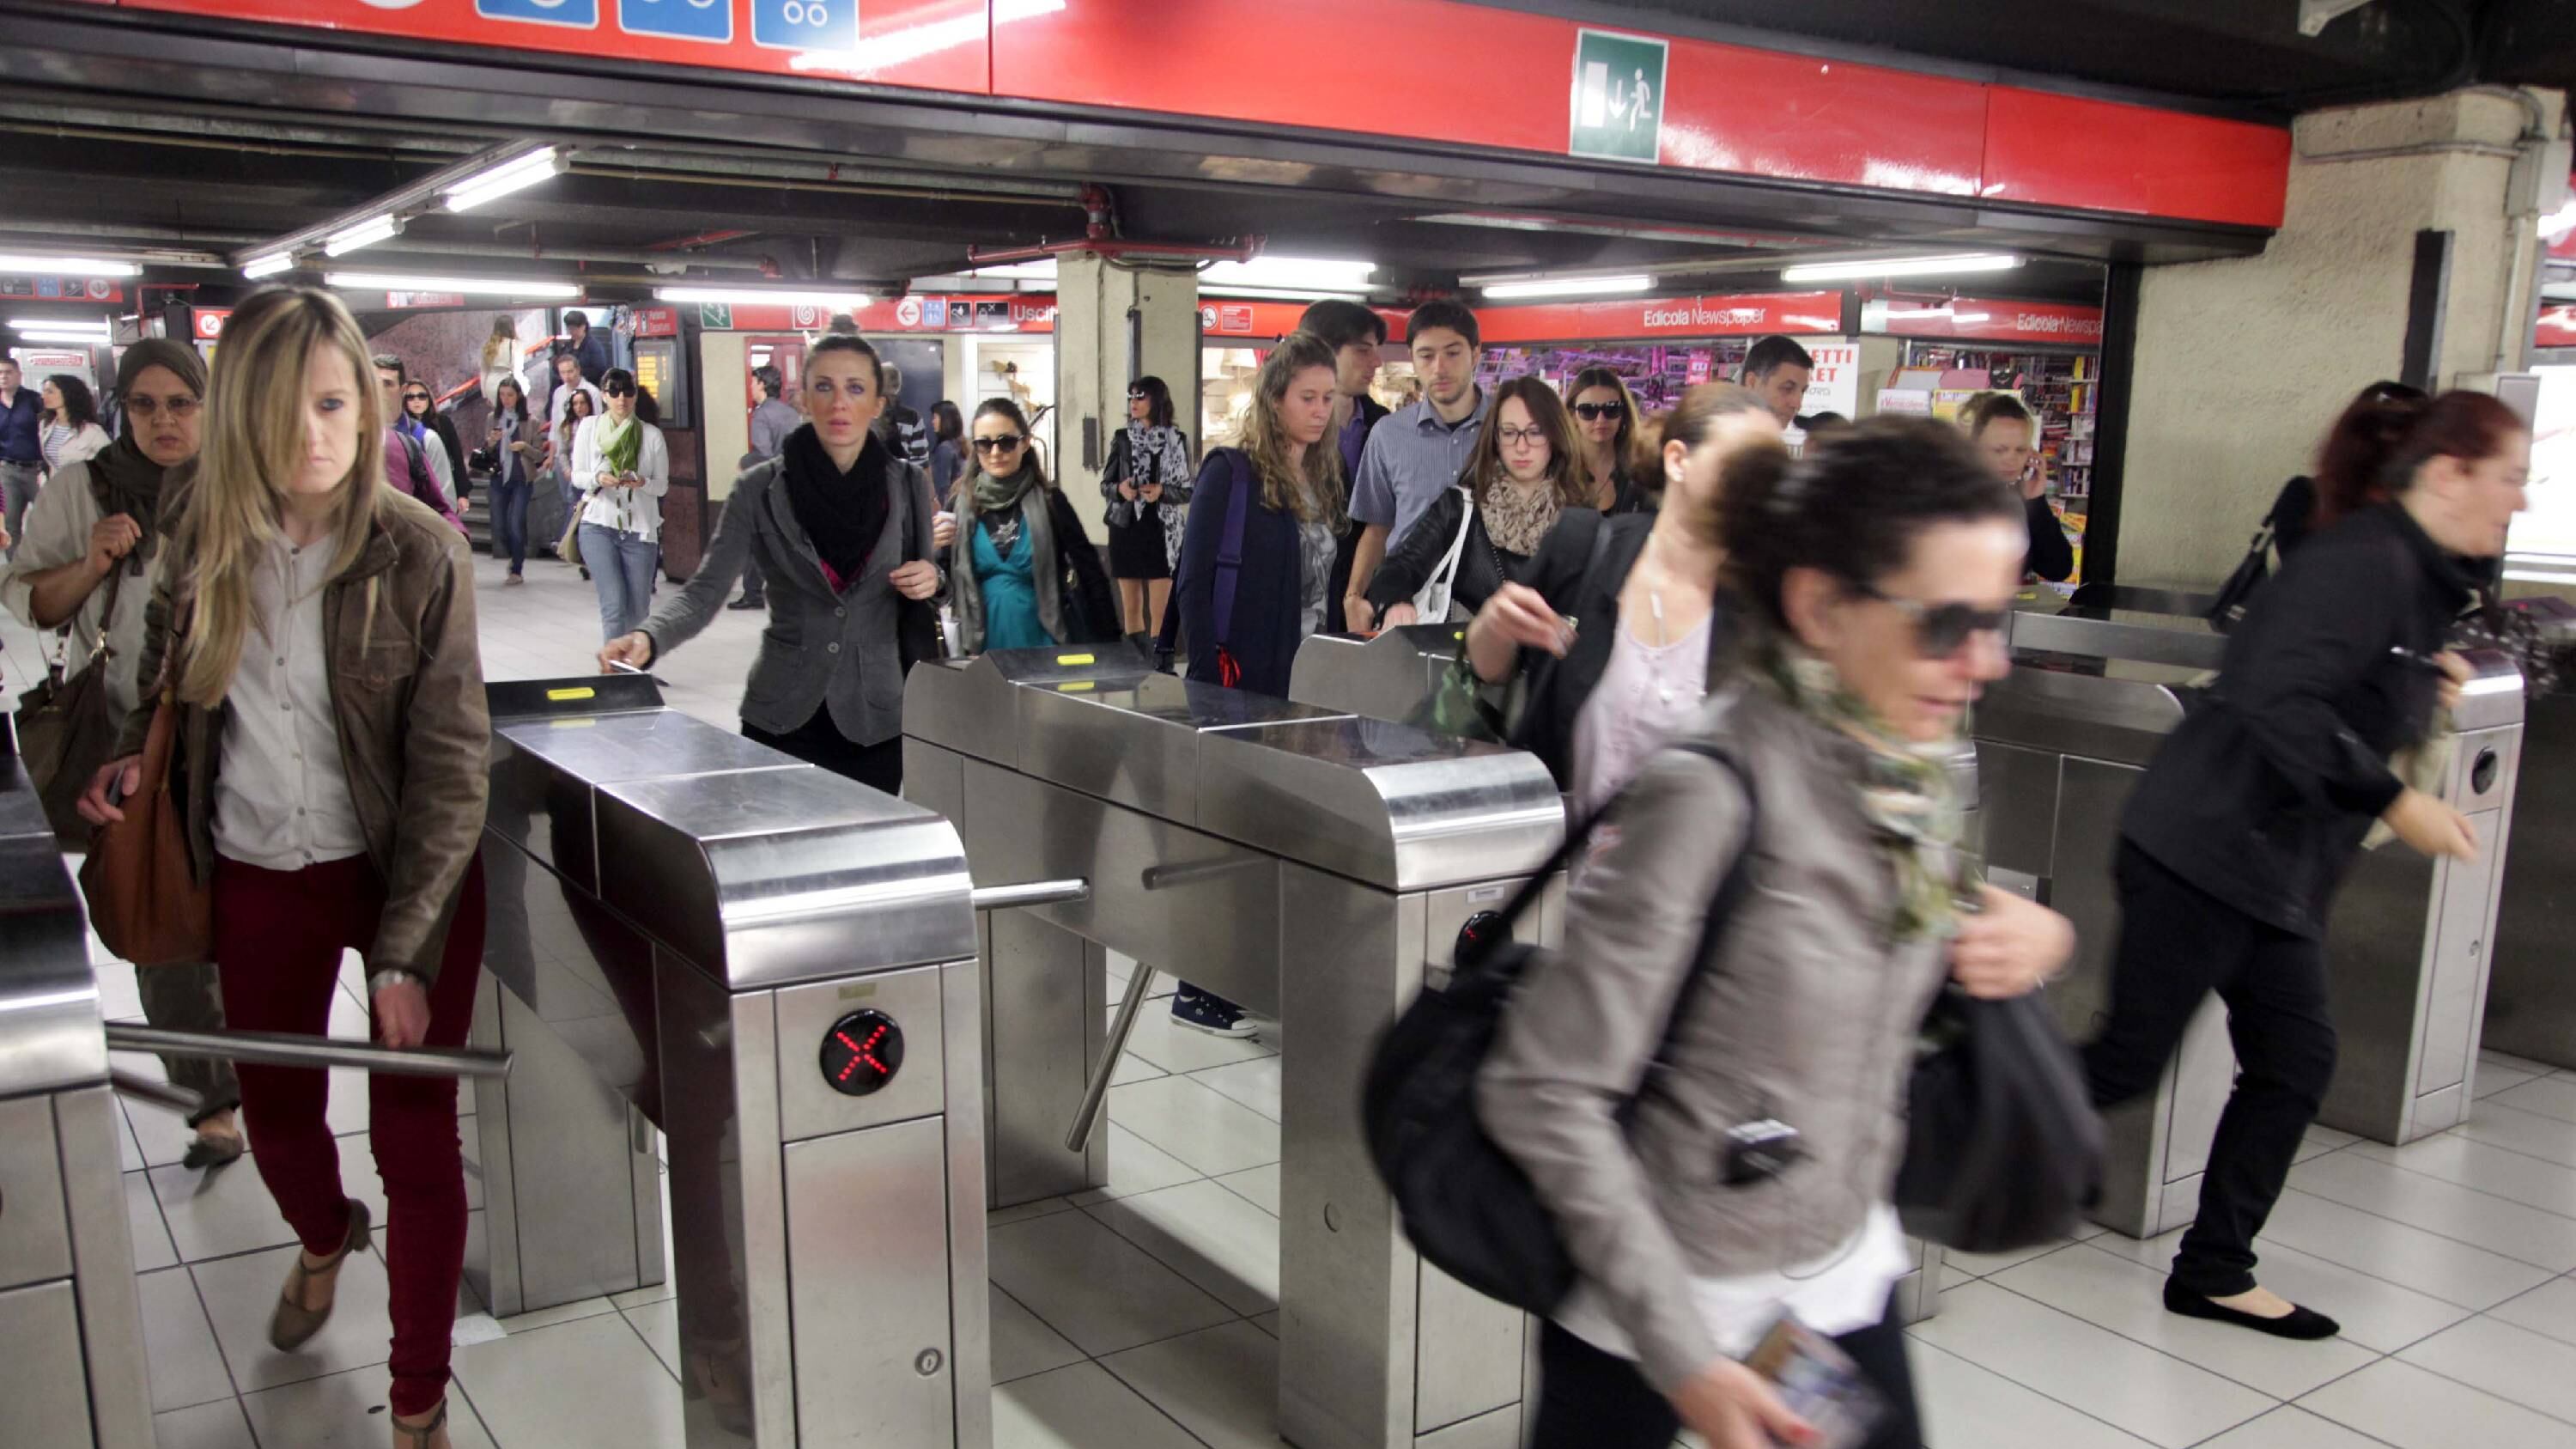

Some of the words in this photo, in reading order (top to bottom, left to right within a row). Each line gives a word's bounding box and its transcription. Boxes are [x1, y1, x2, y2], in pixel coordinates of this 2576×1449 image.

[1014, 303, 1058, 323] Uscit
[1643, 308, 1689, 327] Edicola
[1692, 307, 1766, 328] Newspaper
[2017, 314, 2057, 333] Edicola
[2060, 316, 2103, 336] Newspa
[1811, 349, 1853, 364] ETTI
